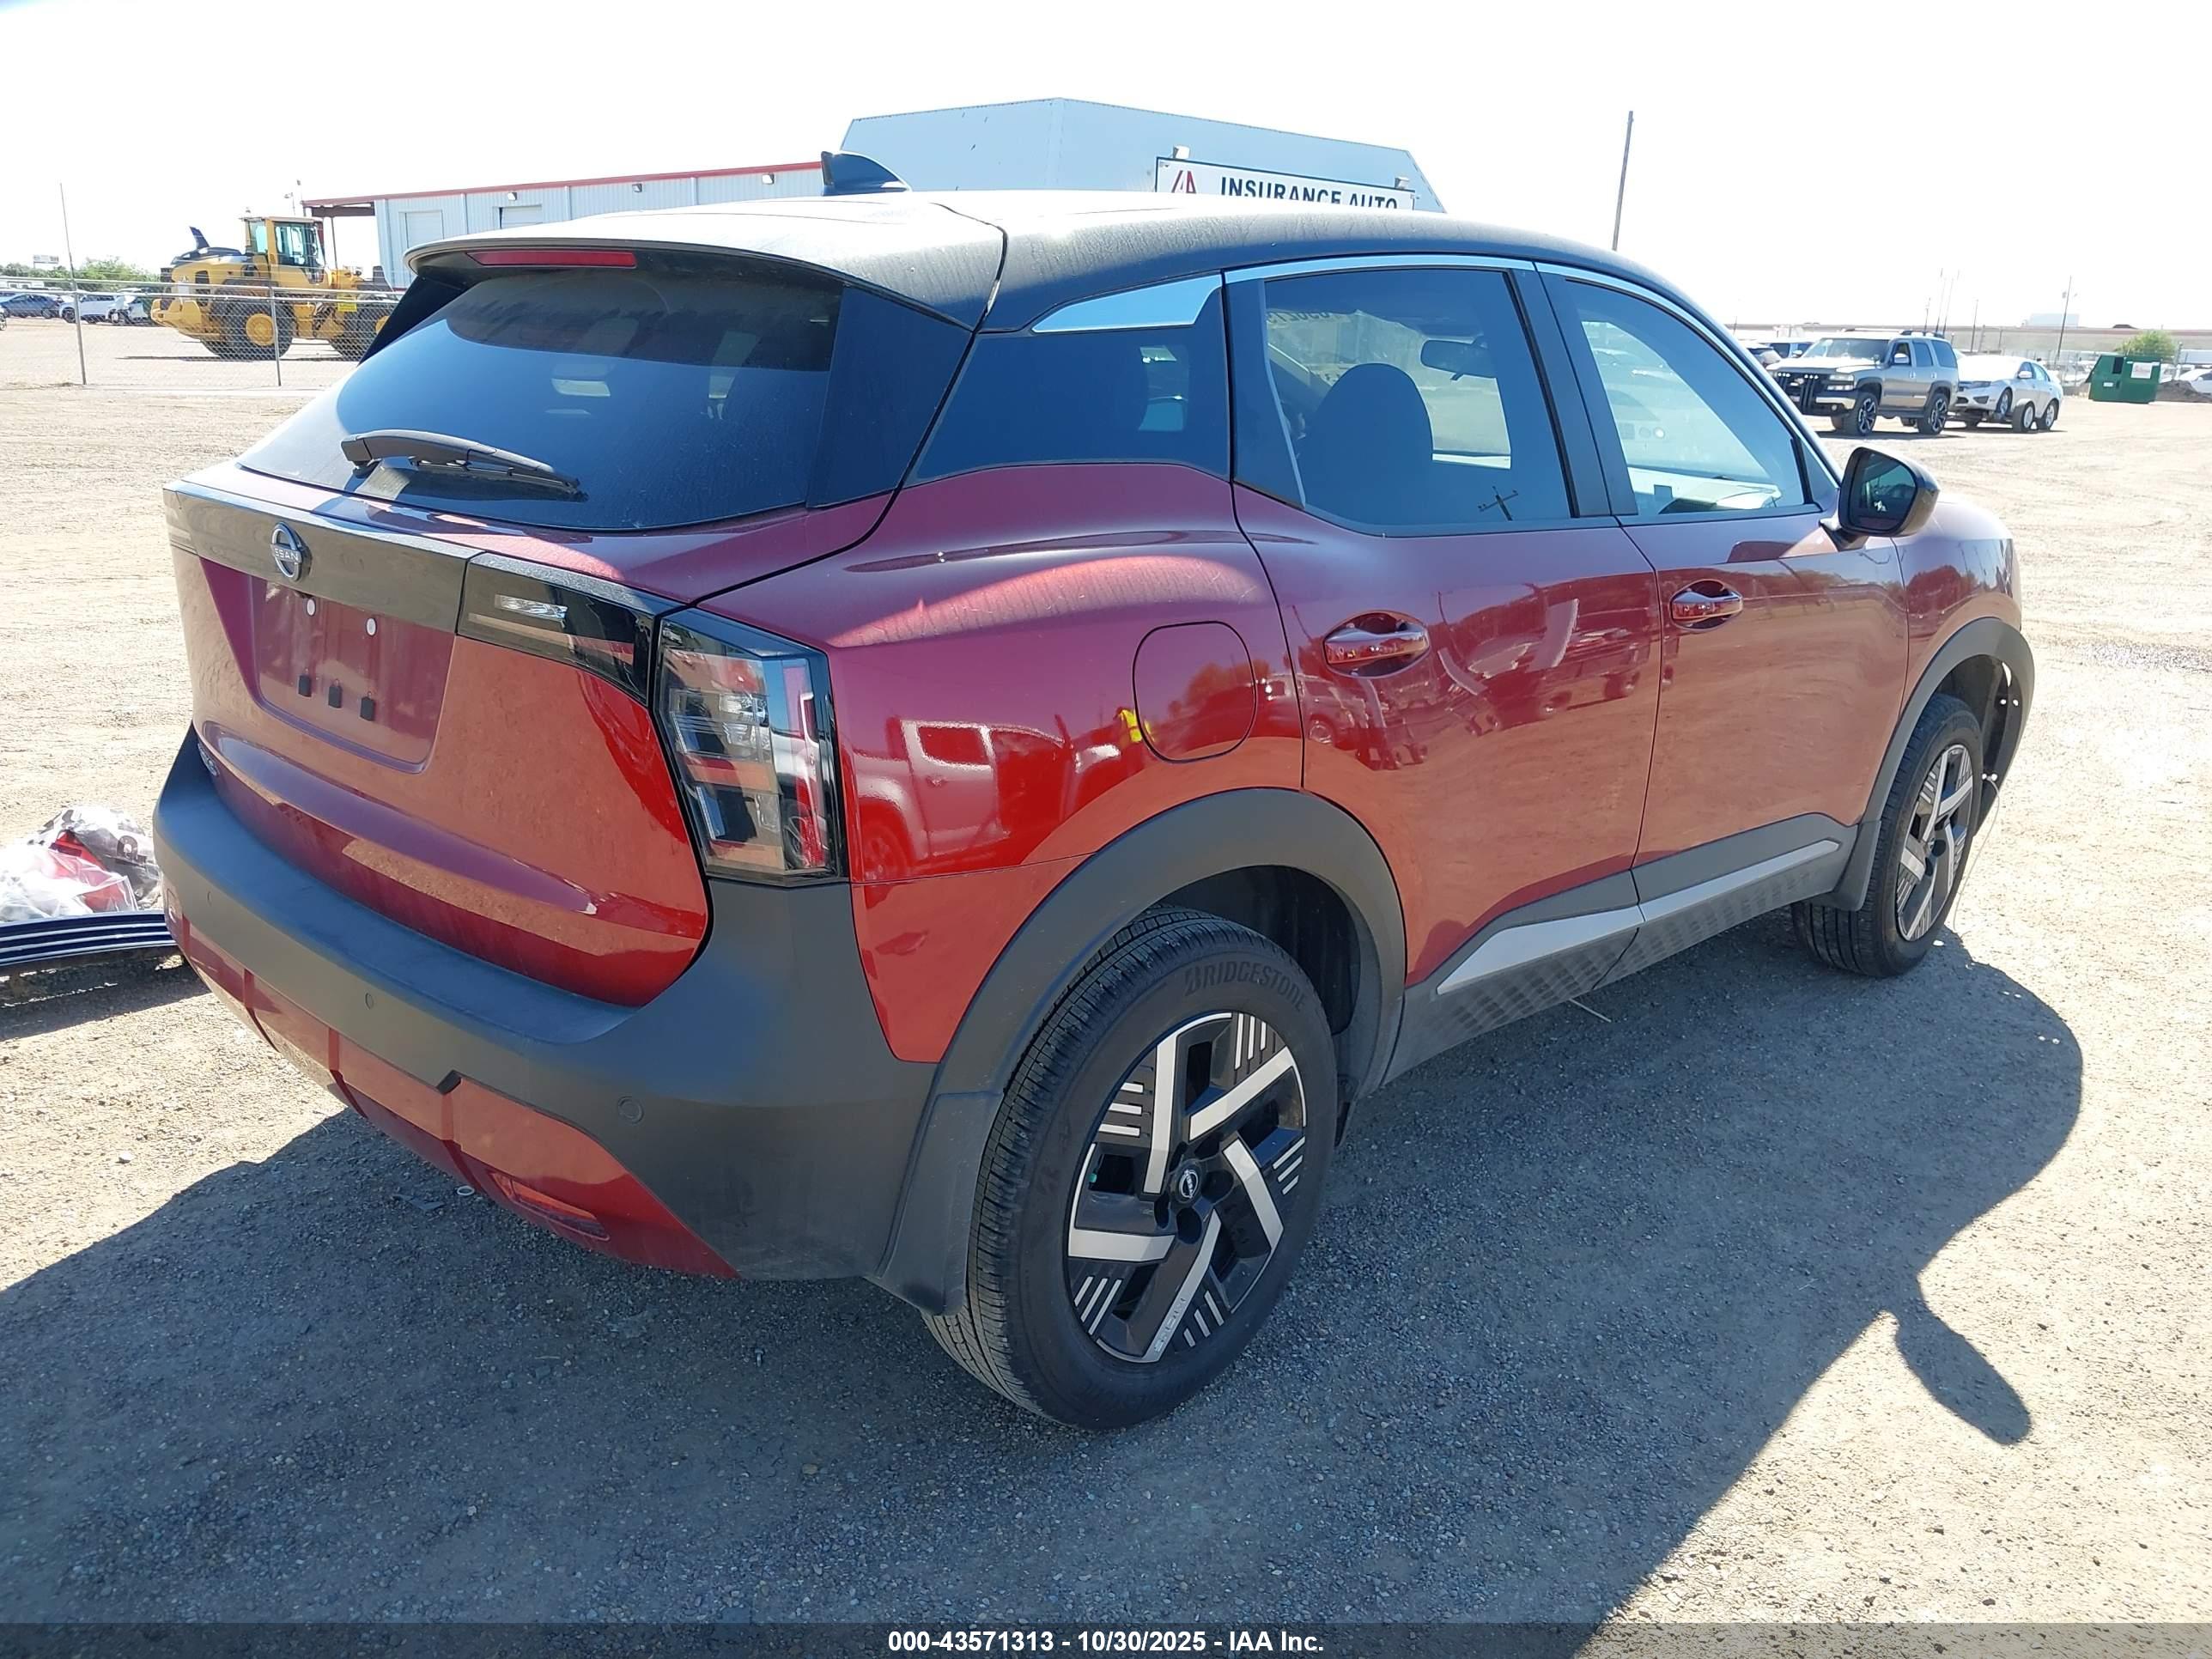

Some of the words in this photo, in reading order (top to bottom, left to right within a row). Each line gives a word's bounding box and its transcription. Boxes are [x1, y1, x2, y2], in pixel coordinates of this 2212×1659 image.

[1220, 176, 1342, 204] INSURANCE
[1348, 192, 1398, 210] AUTO
[1184, 960, 1306, 1012] BRIDGESTONE
